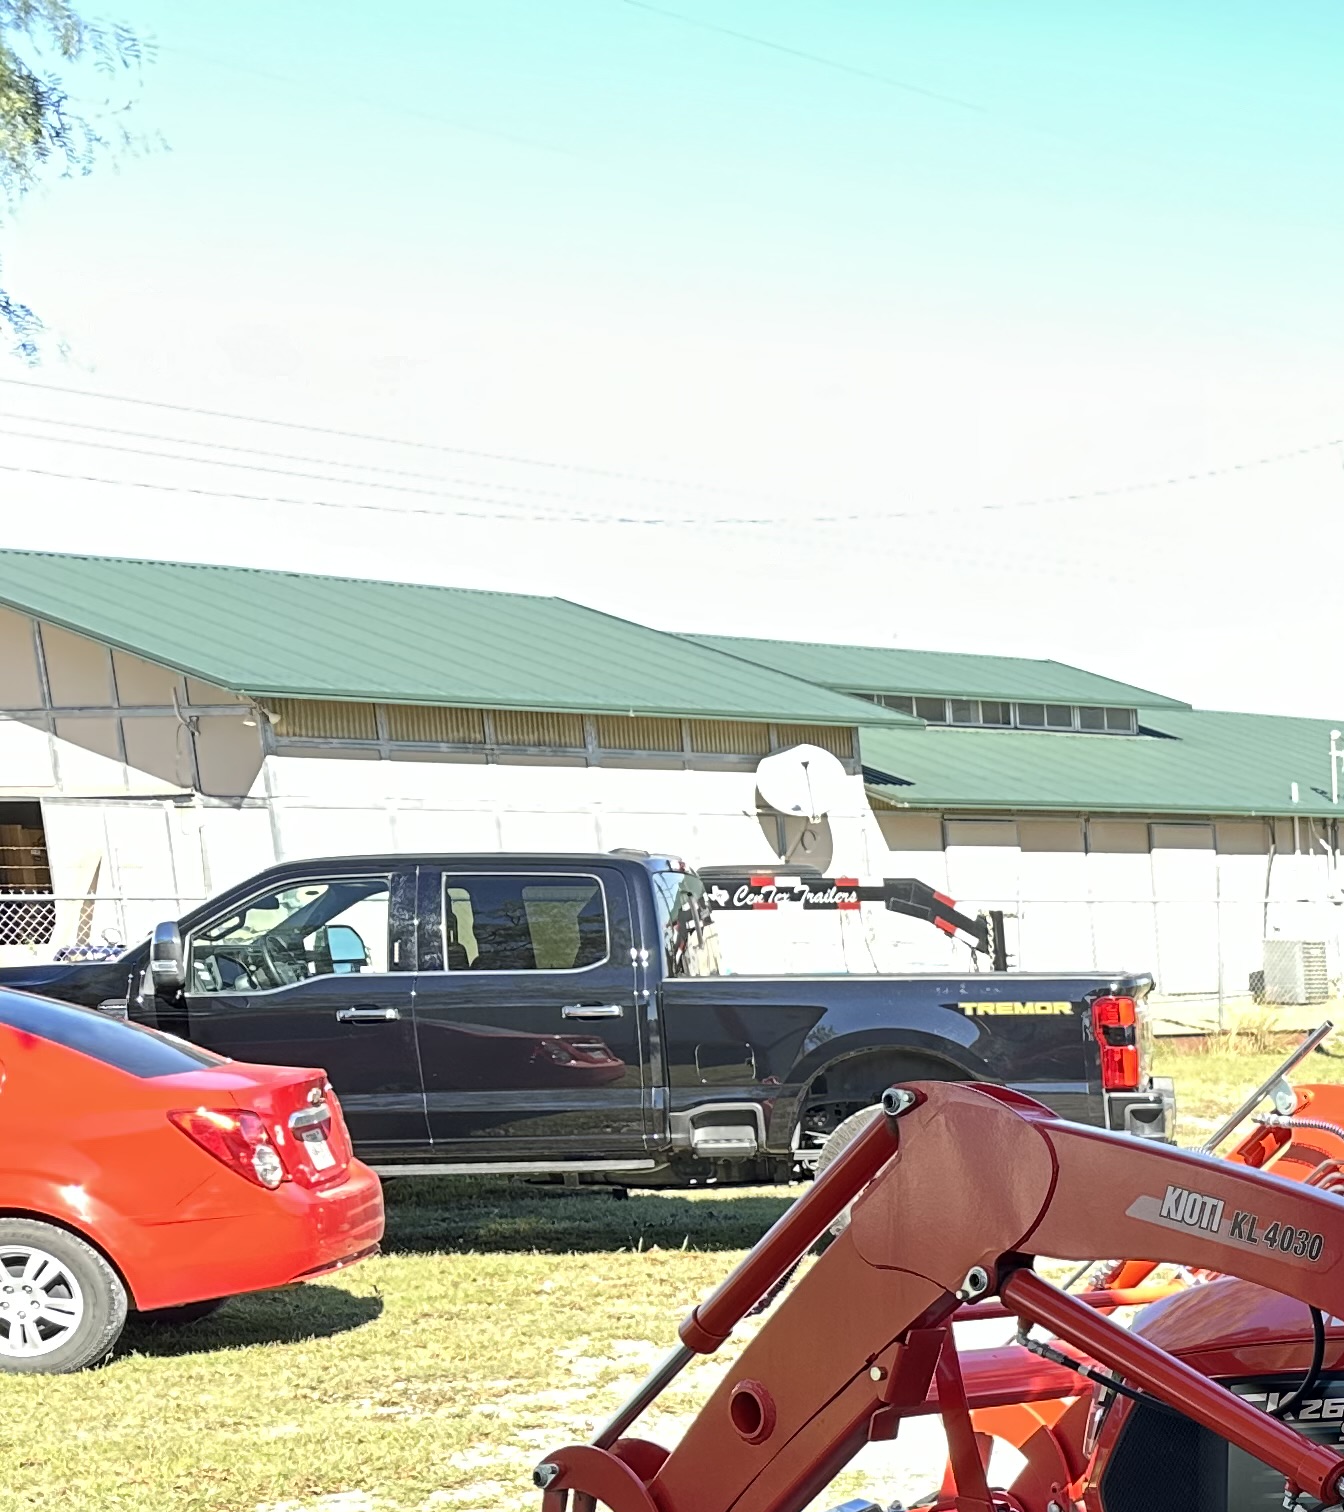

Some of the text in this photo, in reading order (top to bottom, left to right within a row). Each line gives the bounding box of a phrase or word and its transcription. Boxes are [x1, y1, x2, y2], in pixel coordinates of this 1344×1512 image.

[793, 885, 858, 904] Trailers
[957, 1002, 1074, 1015] TREMOR
[1160, 1185, 1325, 1262] KIOTI KL 4030
